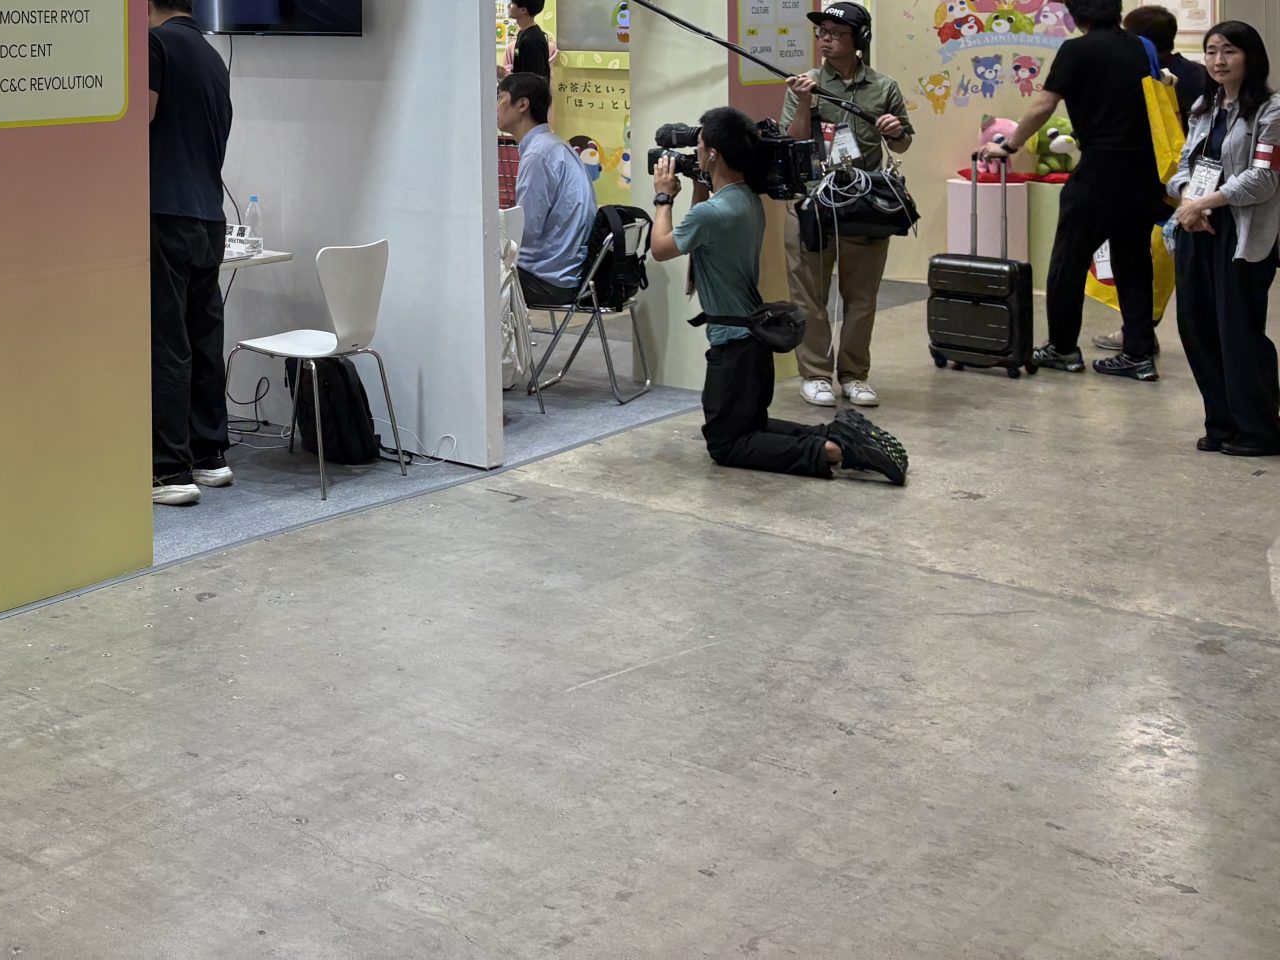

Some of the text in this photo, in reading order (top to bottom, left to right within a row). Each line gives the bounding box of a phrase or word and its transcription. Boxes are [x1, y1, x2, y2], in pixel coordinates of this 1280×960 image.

[0, 10, 90, 24] MONSTER RYOT
[0, 43, 52, 59] DCC ENT
[0, 74, 103, 93] C&C REVOLUTION
